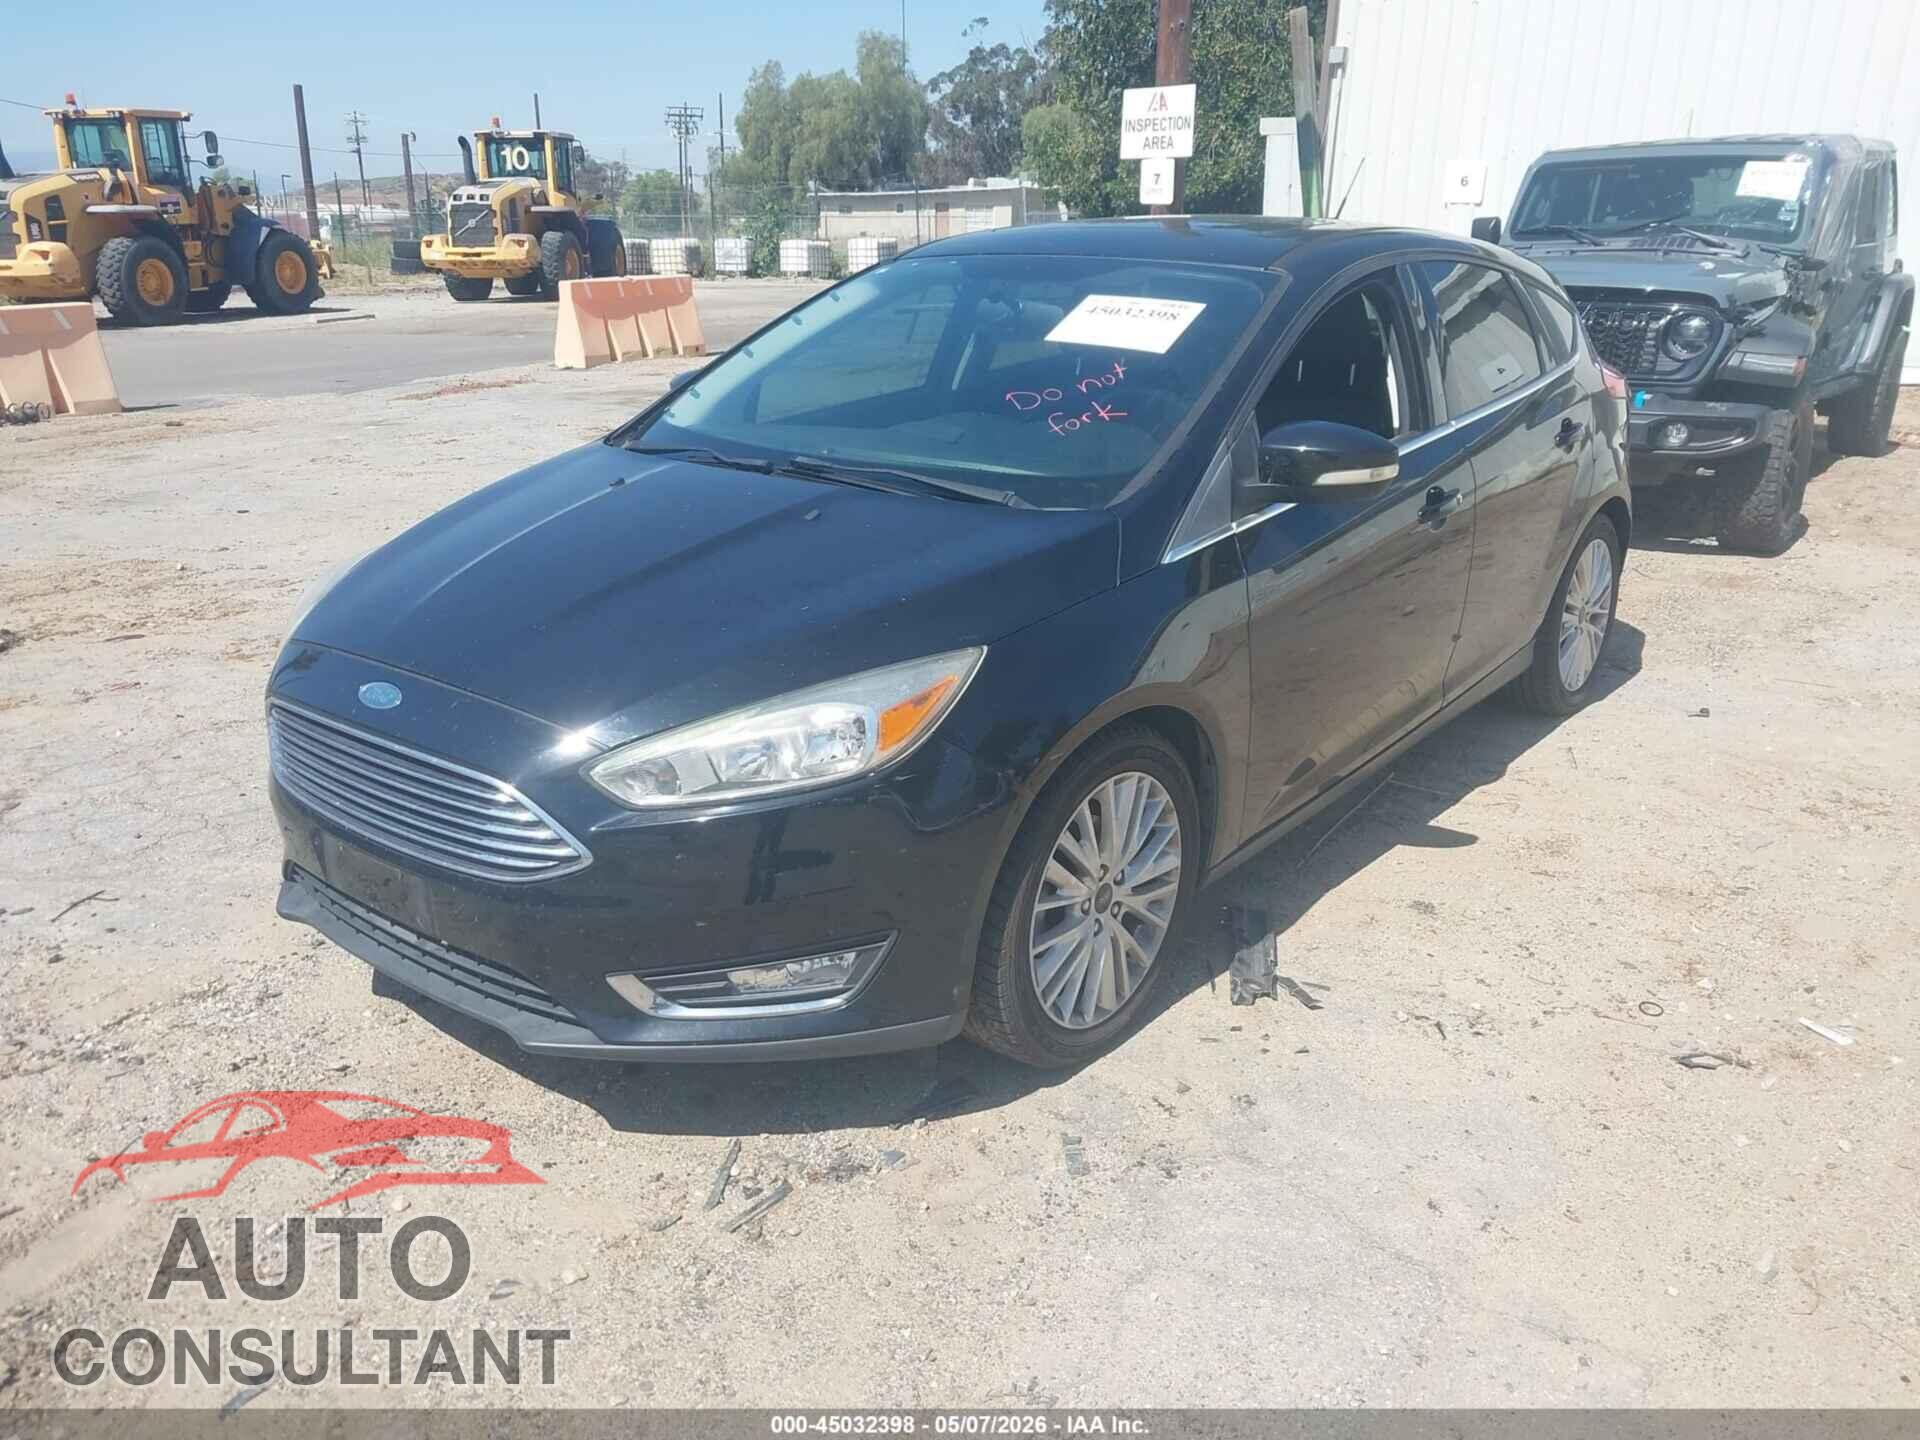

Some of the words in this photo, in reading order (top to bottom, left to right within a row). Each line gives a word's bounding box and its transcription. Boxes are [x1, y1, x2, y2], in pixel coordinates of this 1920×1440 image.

[1125, 115, 1192, 132] INSPECTION
[1142, 135, 1174, 151] AREA
[500, 145, 530, 171] 10
[1152, 173, 1161, 185] 7
[1460, 175, 1469, 187] 6
[1006, 387, 1063, 411] Do
[1047, 401, 1128, 436] fork
